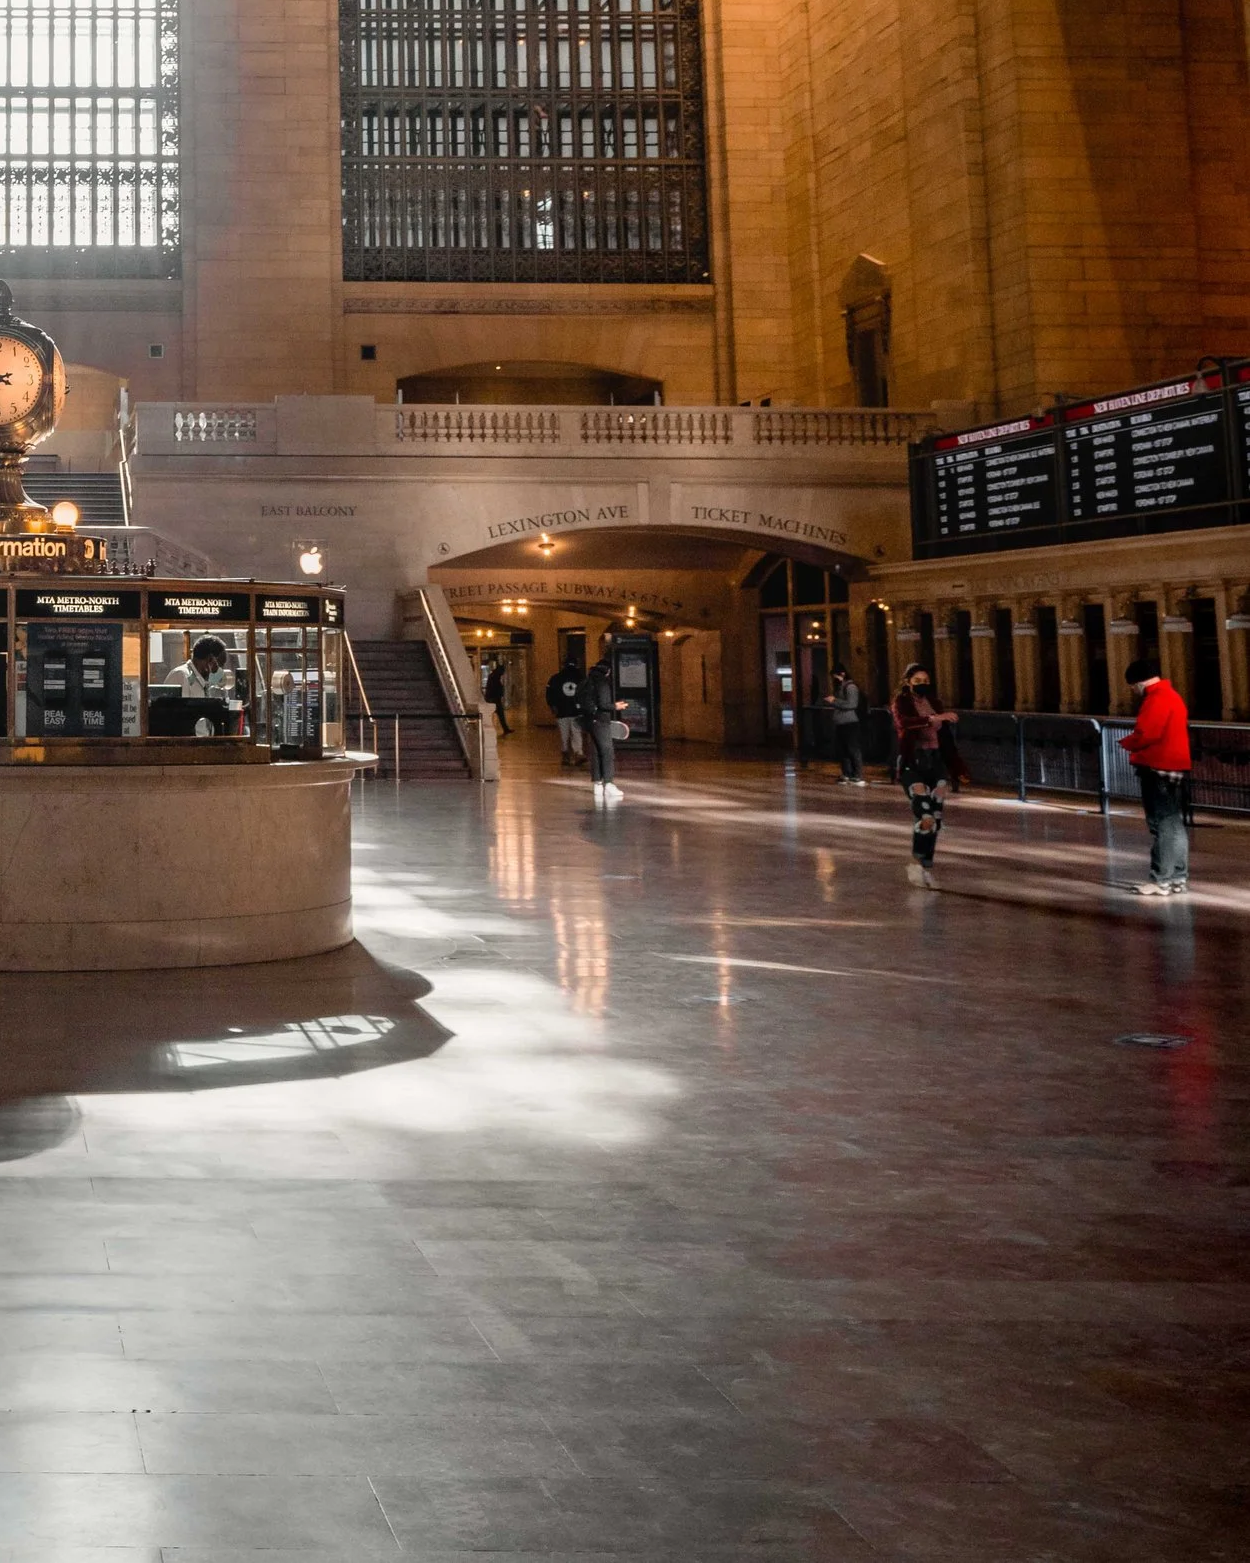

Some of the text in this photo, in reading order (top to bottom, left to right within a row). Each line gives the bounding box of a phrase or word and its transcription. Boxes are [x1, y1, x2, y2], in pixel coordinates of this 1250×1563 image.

[12, 346, 17, 357] 1
[23, 356, 30, 368] 2
[27, 374, 34, 386] 3
[22, 391, 30, 402] 4
[10, 402, 17, 415] 5
[261, 506, 357, 517] EAST BALCONY
[487, 505, 628, 539] LEXINGTON AVE
[691, 506, 848, 545] TICKET MACHINES
[443, 584, 483, 598] TREET
[488, 582, 548, 594] PASSAGE
[556, 583, 615, 597] SUBWAY
[36, 596, 119, 605] MTA METRO-NORTH
[181, 599, 232, 607] METRO-NORTH
[53, 605, 104, 613] TIMETABLES
[178, 607, 220, 615] TIMETABLES
[44, 710, 66, 718] REAL
[83, 710, 105, 718] REAL
[44, 717, 66, 725] EASY
[83, 717, 105, 726] TIME
